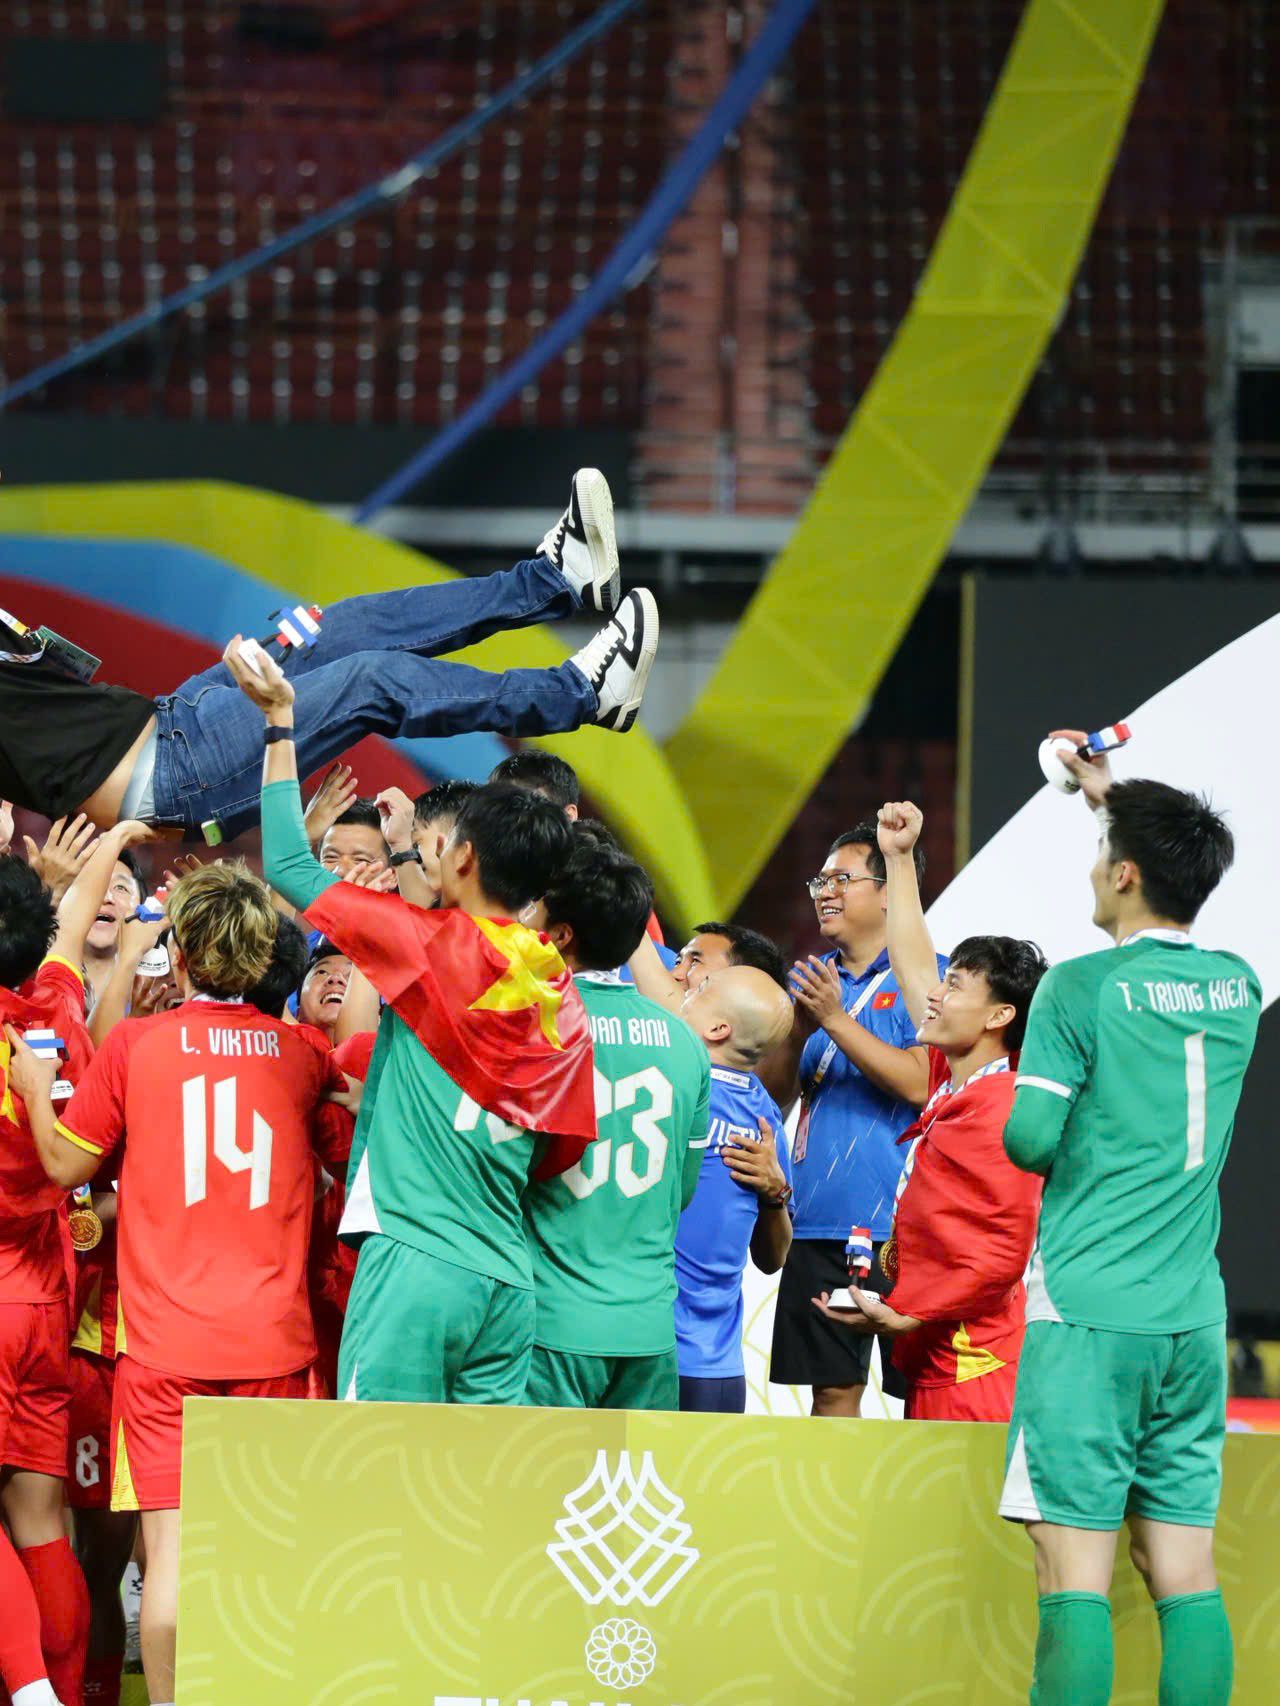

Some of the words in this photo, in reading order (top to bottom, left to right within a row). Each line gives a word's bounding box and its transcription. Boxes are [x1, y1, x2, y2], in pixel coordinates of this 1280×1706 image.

[1116, 982, 1142, 1012] T.
[1144, 982, 1205, 1012] TRUNG
[1208, 976, 1249, 1012] KIEN
[181, 1026, 201, 1055] L.
[207, 1027, 280, 1058] VIKTOR
[627, 1016, 671, 1048] BINH
[1184, 1029, 1208, 1172] 1
[182, 1074, 274, 1211] 14
[75, 1434, 100, 1488] 8
